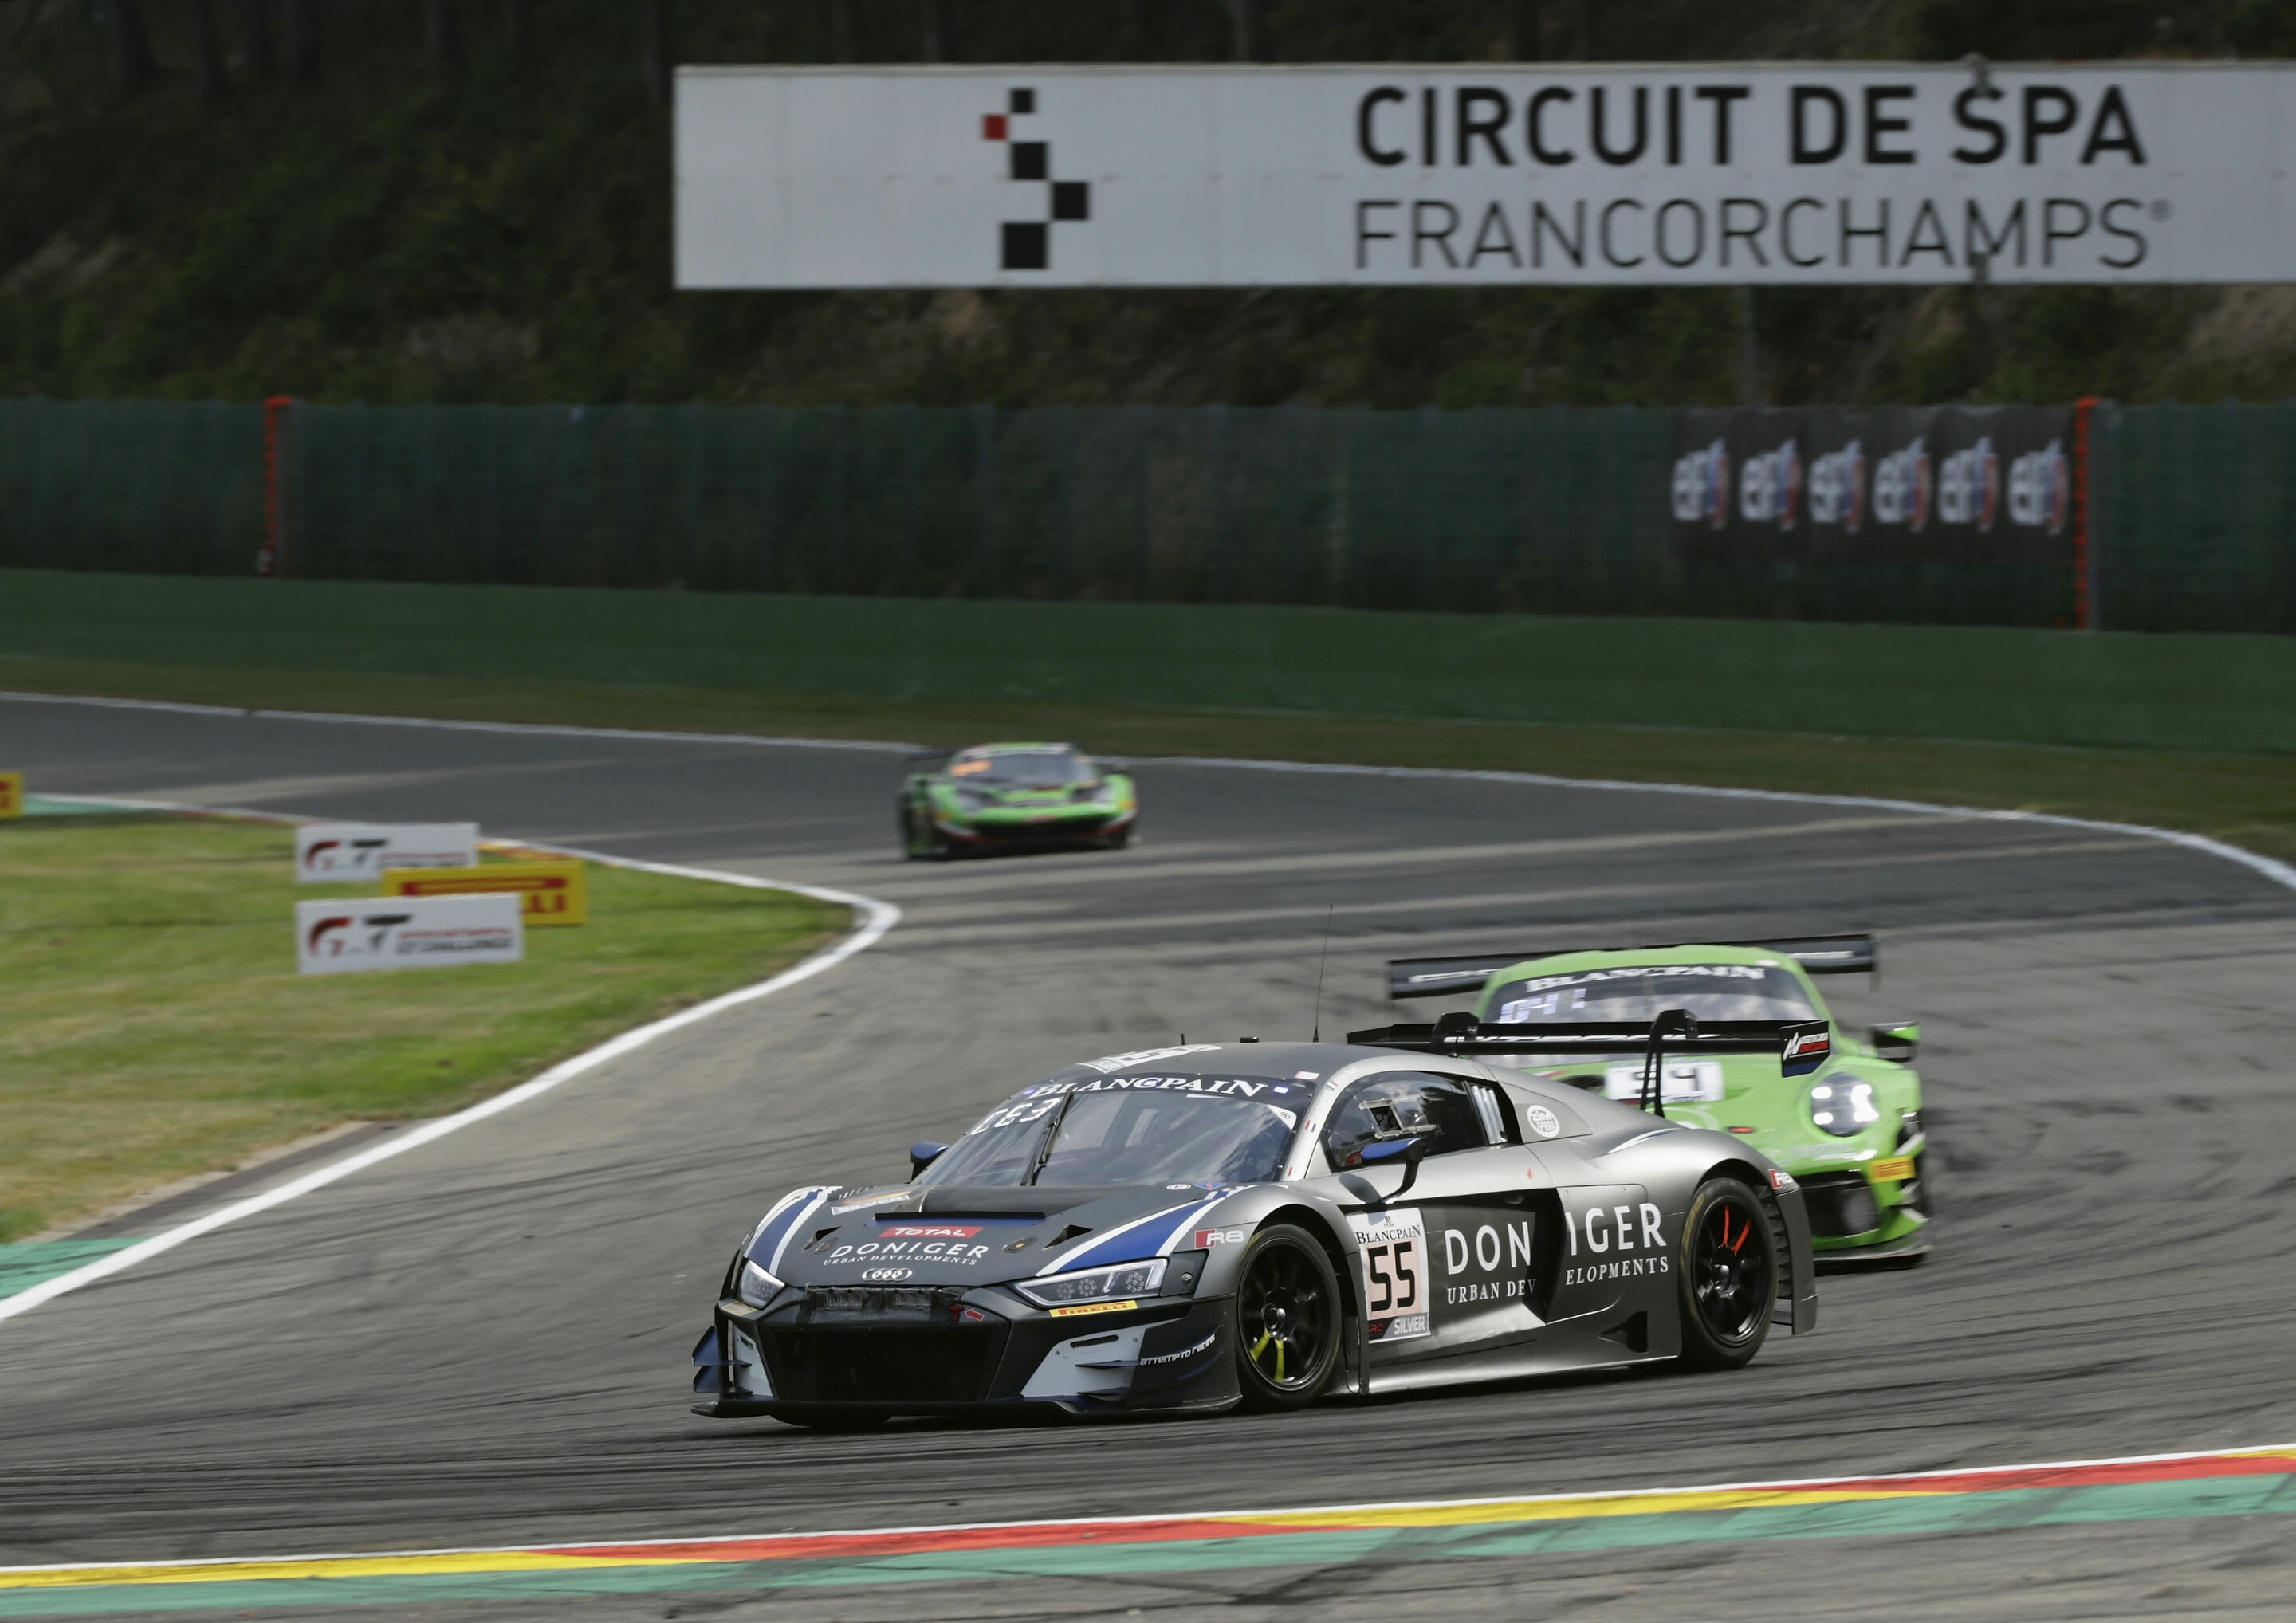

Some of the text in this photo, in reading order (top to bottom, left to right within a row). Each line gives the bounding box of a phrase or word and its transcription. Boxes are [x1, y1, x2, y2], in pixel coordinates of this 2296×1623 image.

[1355, 84, 2147, 166] CIRCUIT DE SPA
[1354, 197, 2149, 269] FRANCORCHAMPS
[1524, 965, 1767, 993] BLANCPAIN
[1025, 1076, 1268, 1098] BLANCPAIN
[894, 1227, 967, 1236] TOTAL
[1205, 1230, 1244, 1246] R8
[1355, 1224, 1421, 1244] BLANCPAIN
[823, 1255, 978, 1266] URBAN DEVELOPMENTS
[829, 1241, 989, 1259] DONIGER
[1367, 1241, 1416, 1312] 55
[1447, 1282, 1500, 1305] URBAN
[1394, 1315, 1426, 1334] SILVER
